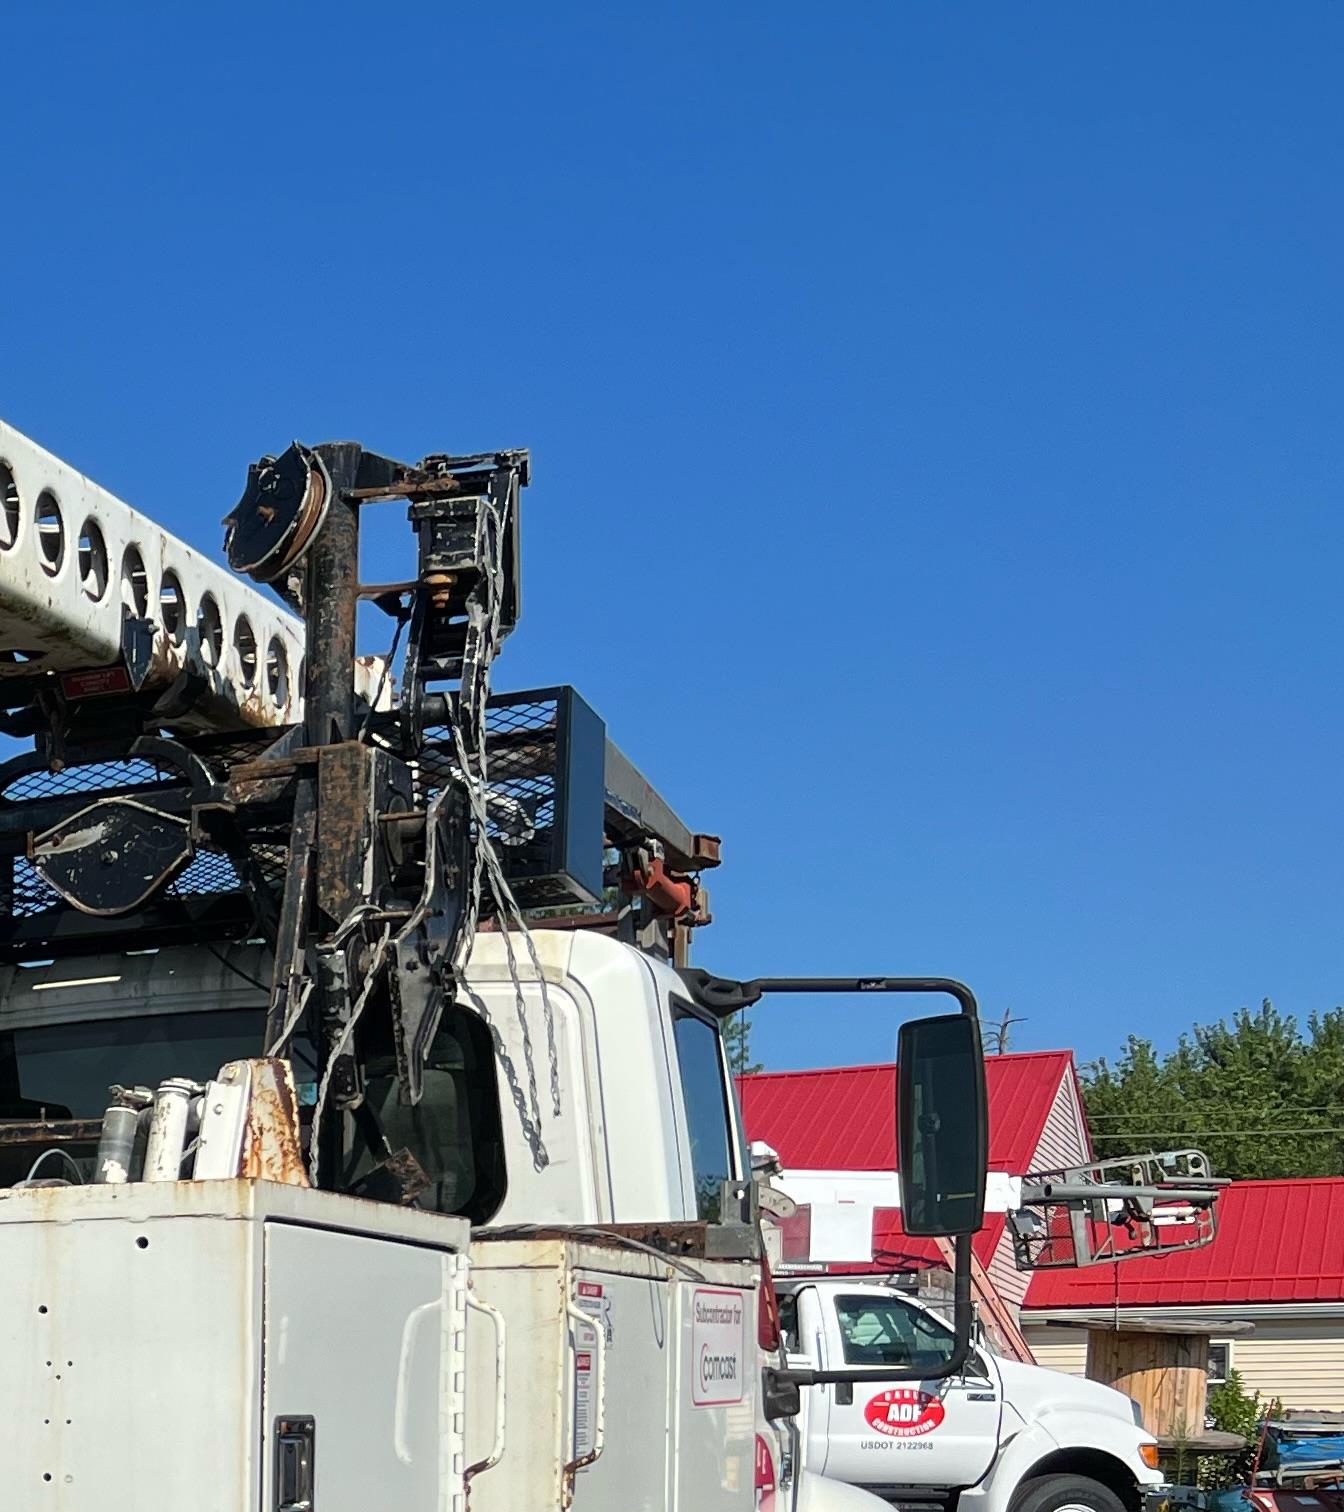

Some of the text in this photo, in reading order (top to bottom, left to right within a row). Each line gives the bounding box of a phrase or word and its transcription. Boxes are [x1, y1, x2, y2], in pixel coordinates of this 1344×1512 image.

[695, 1301, 732, 1324] Subcontractor
[887, 1403, 923, 1423] ADF
[871, 1417, 937, 1437] CONSTRUCTION
[861, 1441, 934, 1451] USDOT 2122968
